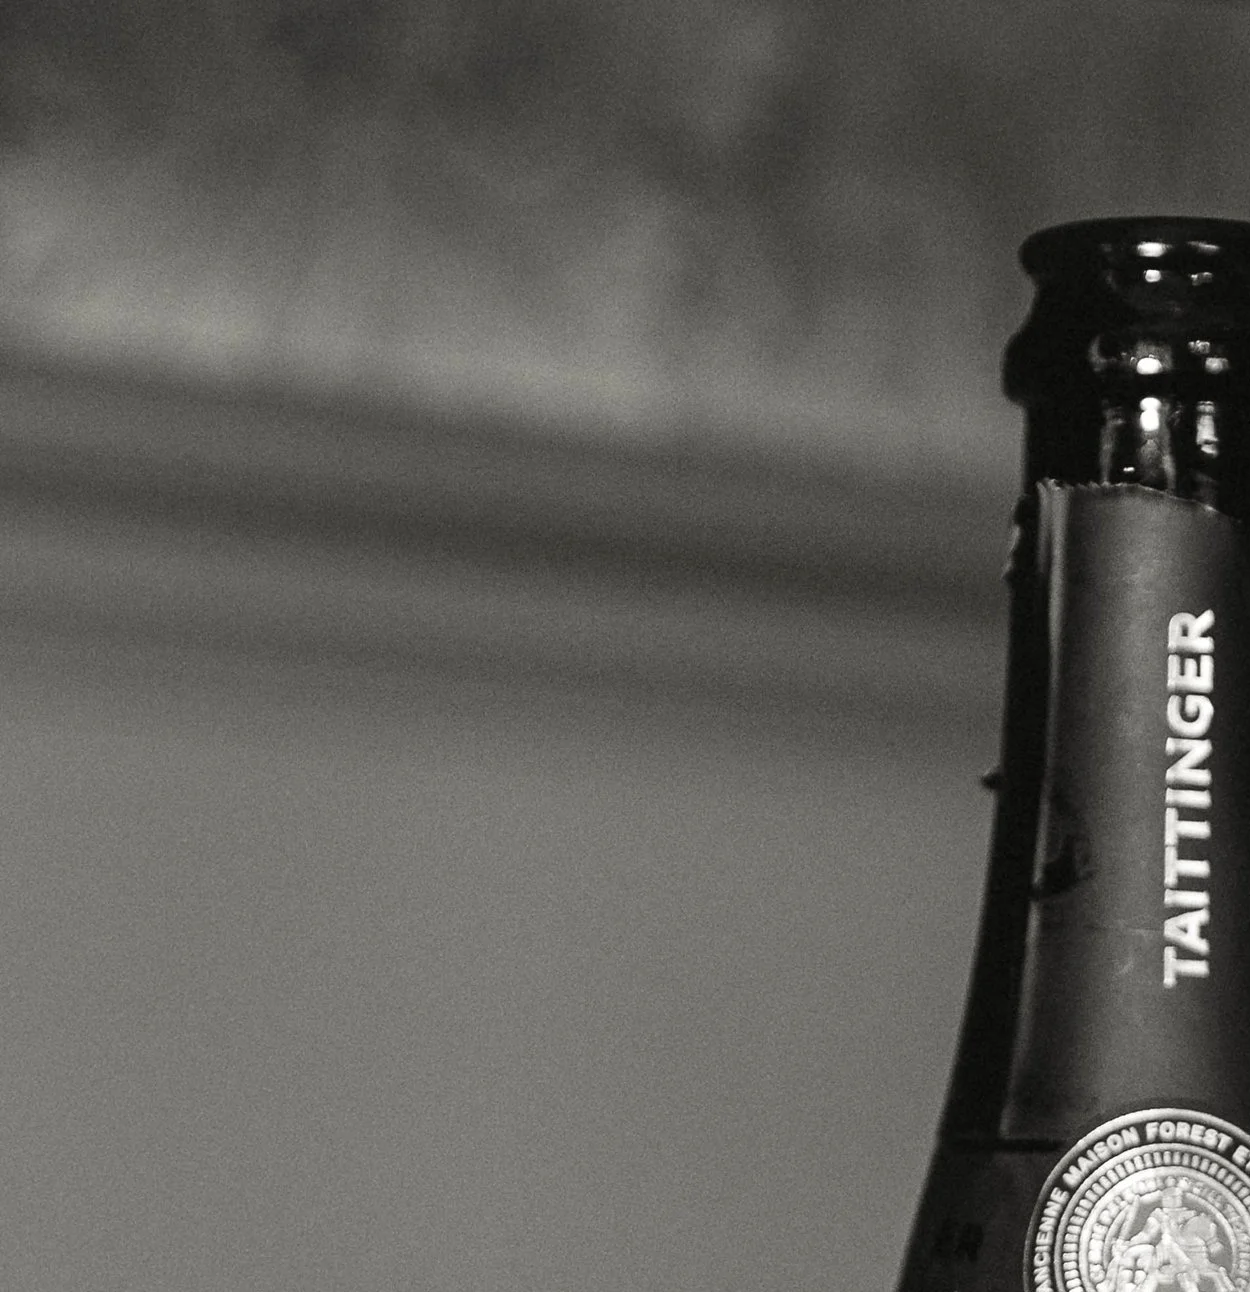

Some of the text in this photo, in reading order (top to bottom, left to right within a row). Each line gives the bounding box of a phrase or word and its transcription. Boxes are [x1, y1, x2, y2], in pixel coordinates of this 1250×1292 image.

[1163, 609, 1215, 988] TAITTINGER
[1062, 1126, 1140, 1187] MAISON
[1145, 1121, 1233, 1151] FOREST
